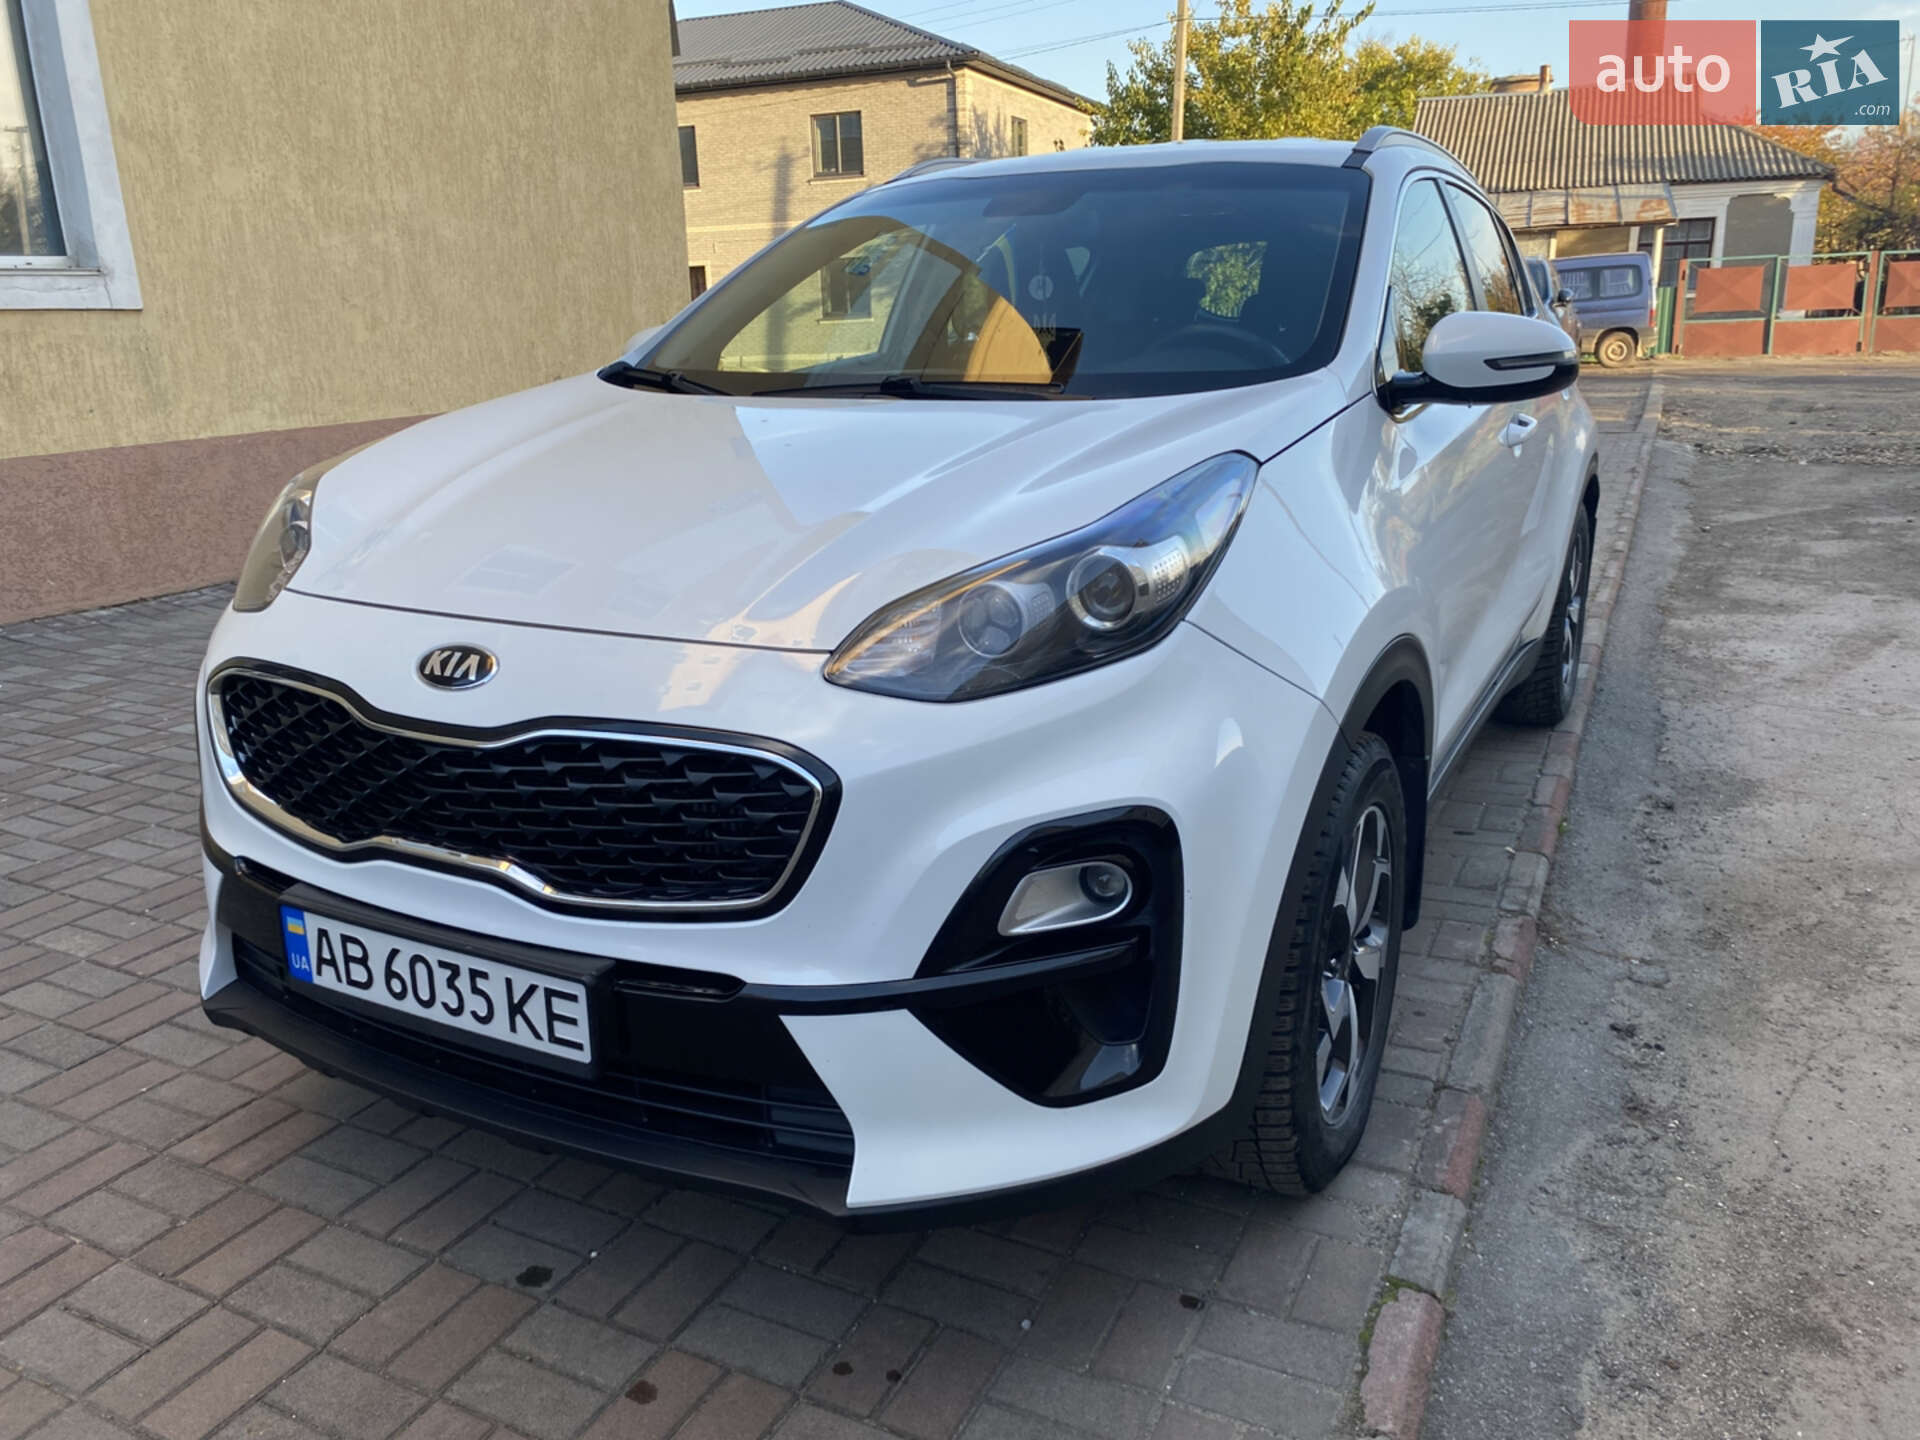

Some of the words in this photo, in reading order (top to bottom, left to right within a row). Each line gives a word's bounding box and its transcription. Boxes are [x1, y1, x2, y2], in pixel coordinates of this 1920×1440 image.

[423, 650, 481, 681] KIA
[291, 952, 310, 972] UA
[315, 927, 374, 991] AB
[384, 947, 495, 1026] 6035
[504, 976, 585, 1052] KE
